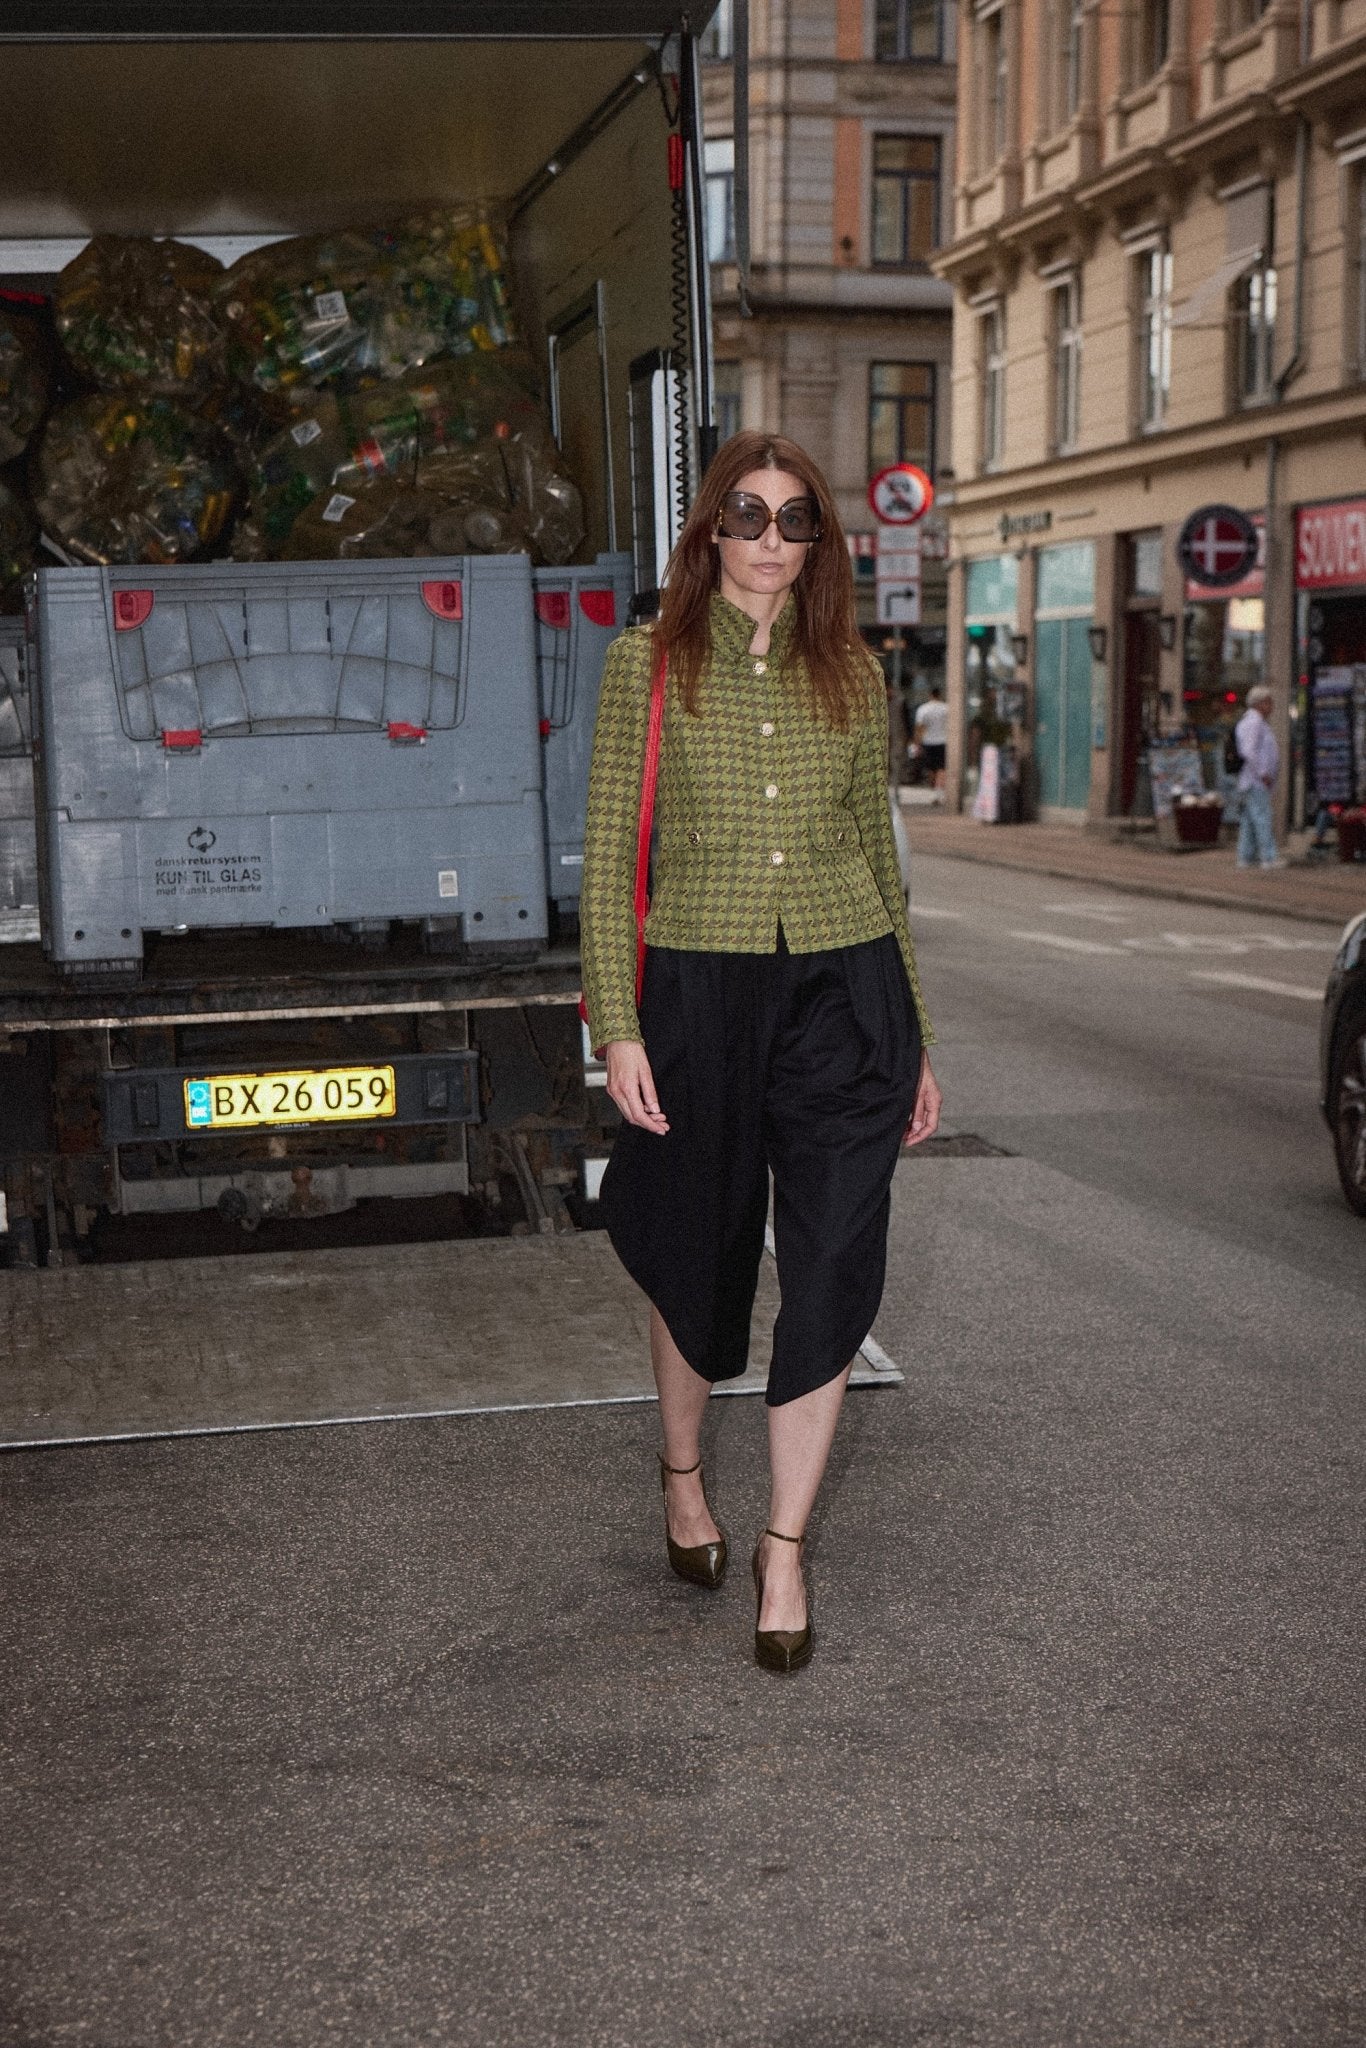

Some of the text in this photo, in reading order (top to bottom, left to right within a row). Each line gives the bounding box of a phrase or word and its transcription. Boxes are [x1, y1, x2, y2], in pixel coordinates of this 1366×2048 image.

[155, 868, 261, 885] KUN TIL GLAS
[214, 1076, 387, 1117] BX 26 059
